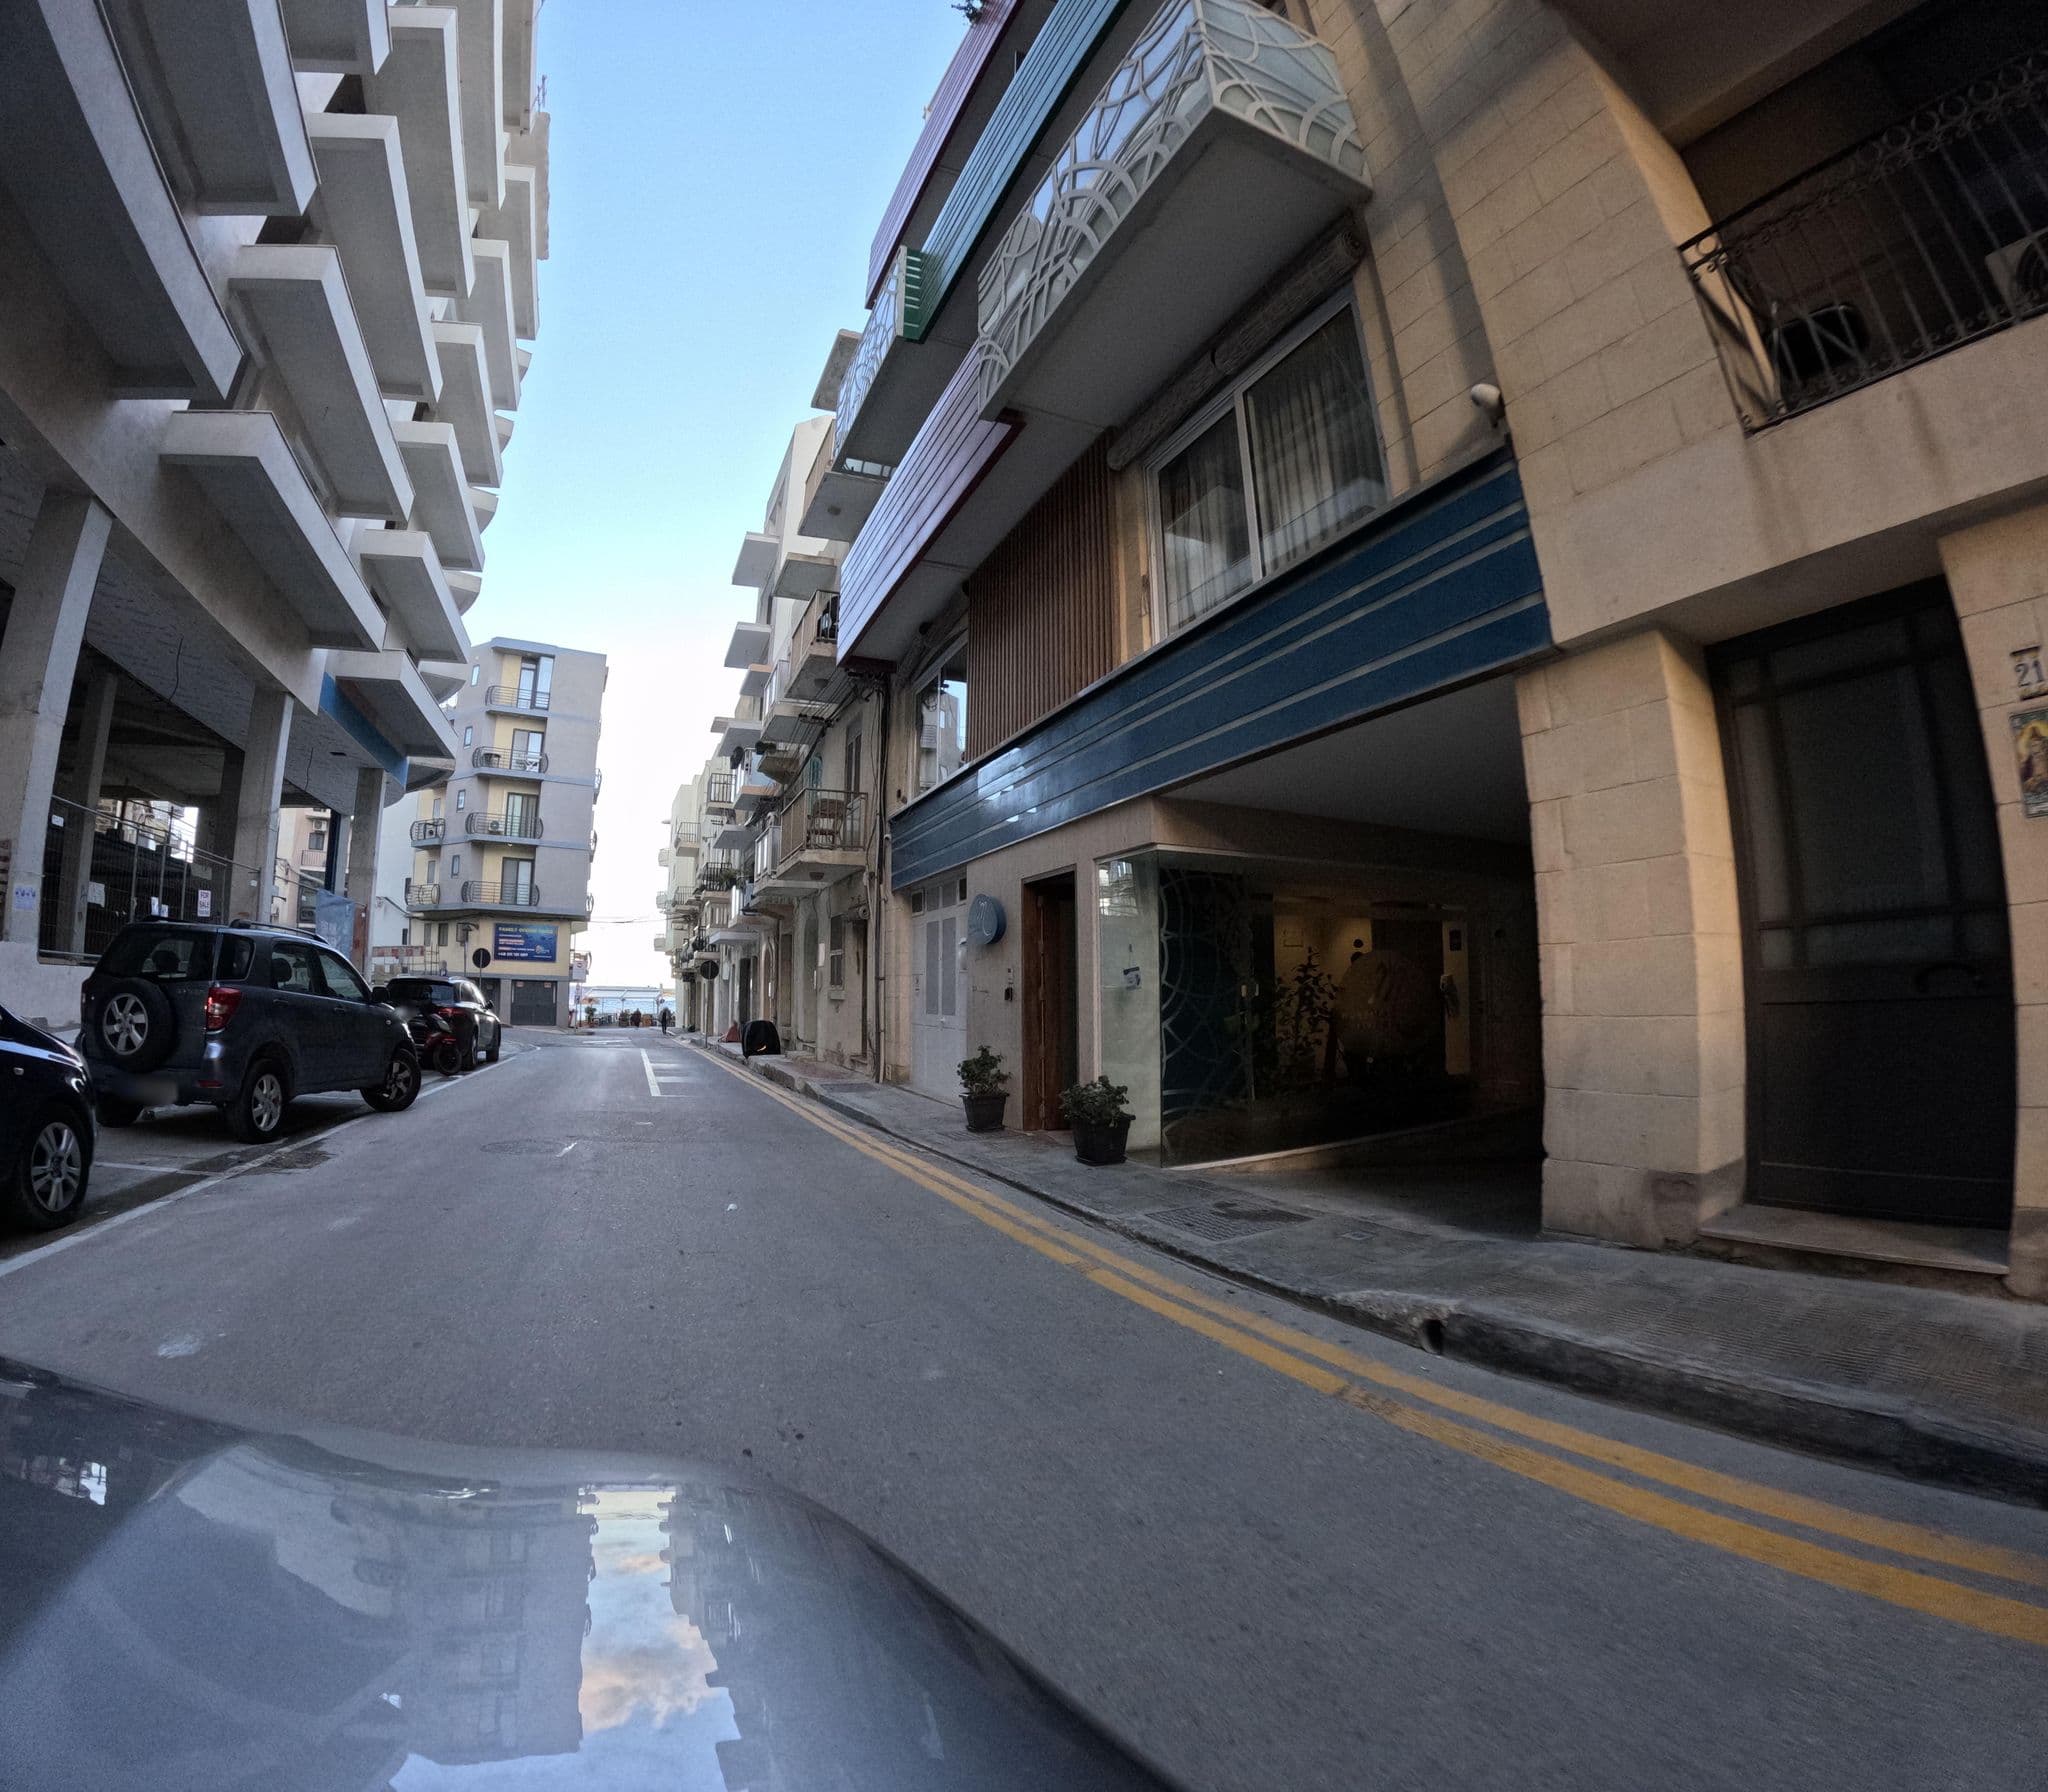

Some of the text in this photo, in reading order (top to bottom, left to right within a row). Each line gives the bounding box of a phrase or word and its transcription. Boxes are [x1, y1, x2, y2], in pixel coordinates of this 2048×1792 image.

[2014, 659, 2044, 688] 21
[200, 891, 209, 899] FOR
[199, 901, 210, 909] SALE
